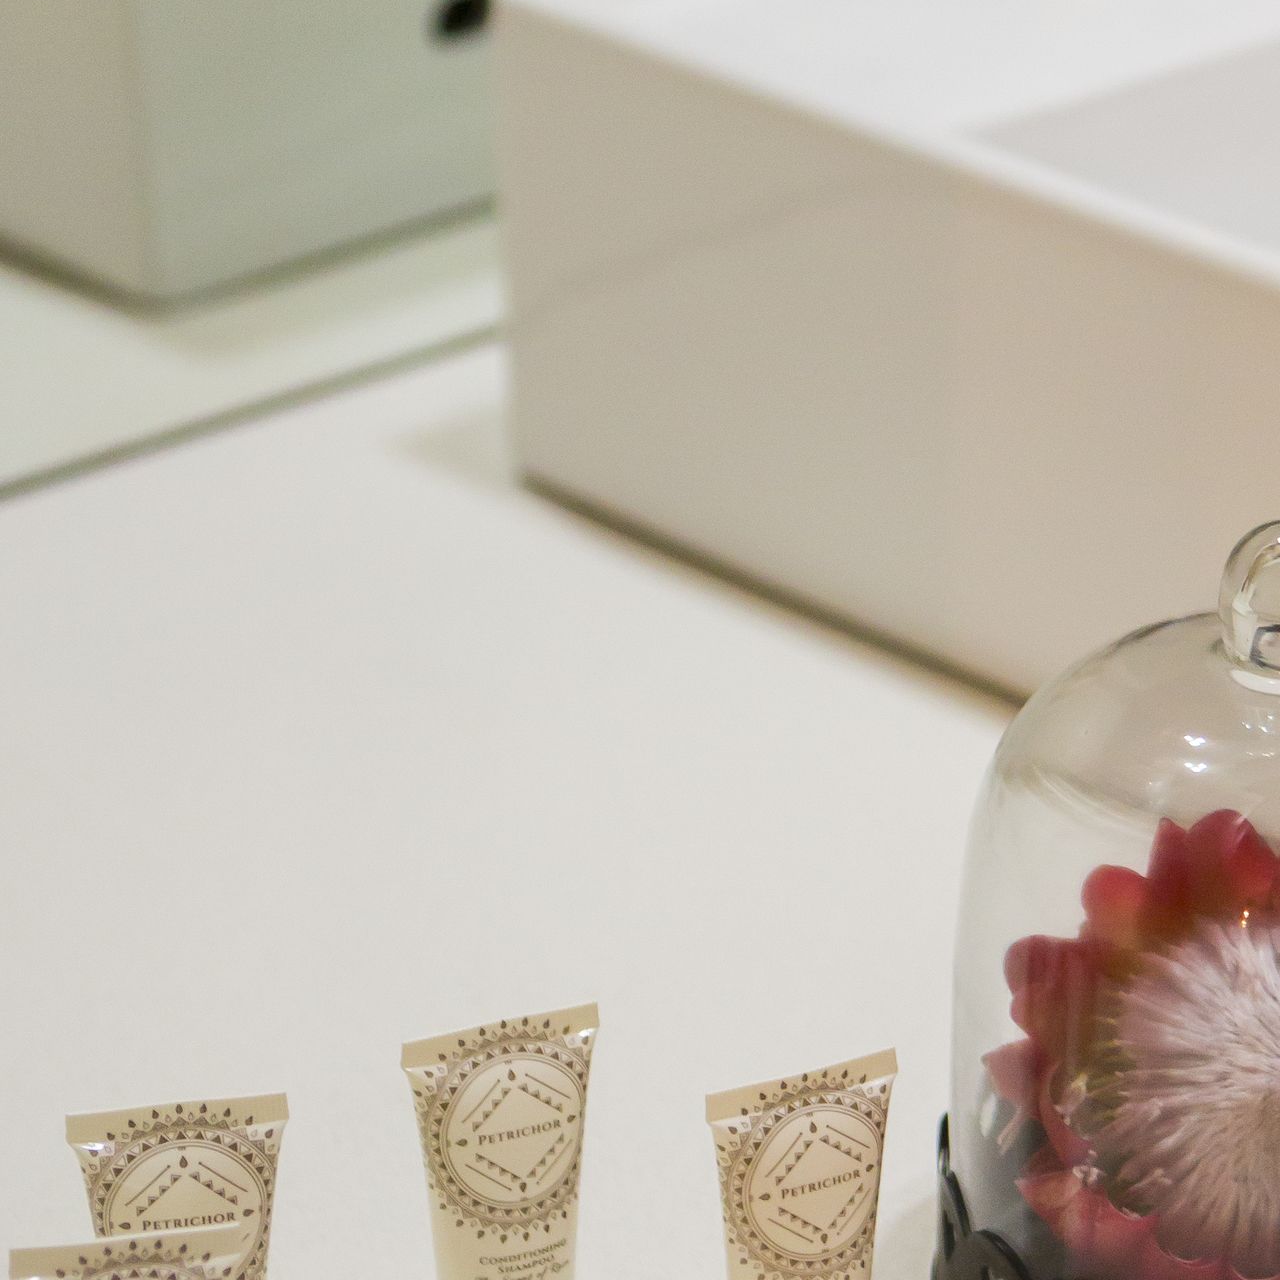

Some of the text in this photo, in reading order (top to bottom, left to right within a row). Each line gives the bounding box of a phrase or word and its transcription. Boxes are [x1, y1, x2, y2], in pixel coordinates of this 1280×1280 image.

[477, 1118, 561, 1146] PETRICHOR
[781, 1169, 861, 1200] PETRICHOR
[142, 1211, 236, 1231] PETRICHOR
[479, 1238, 567, 1266] CONDITIONING
[497, 1254, 555, 1274] SHAMPOO
